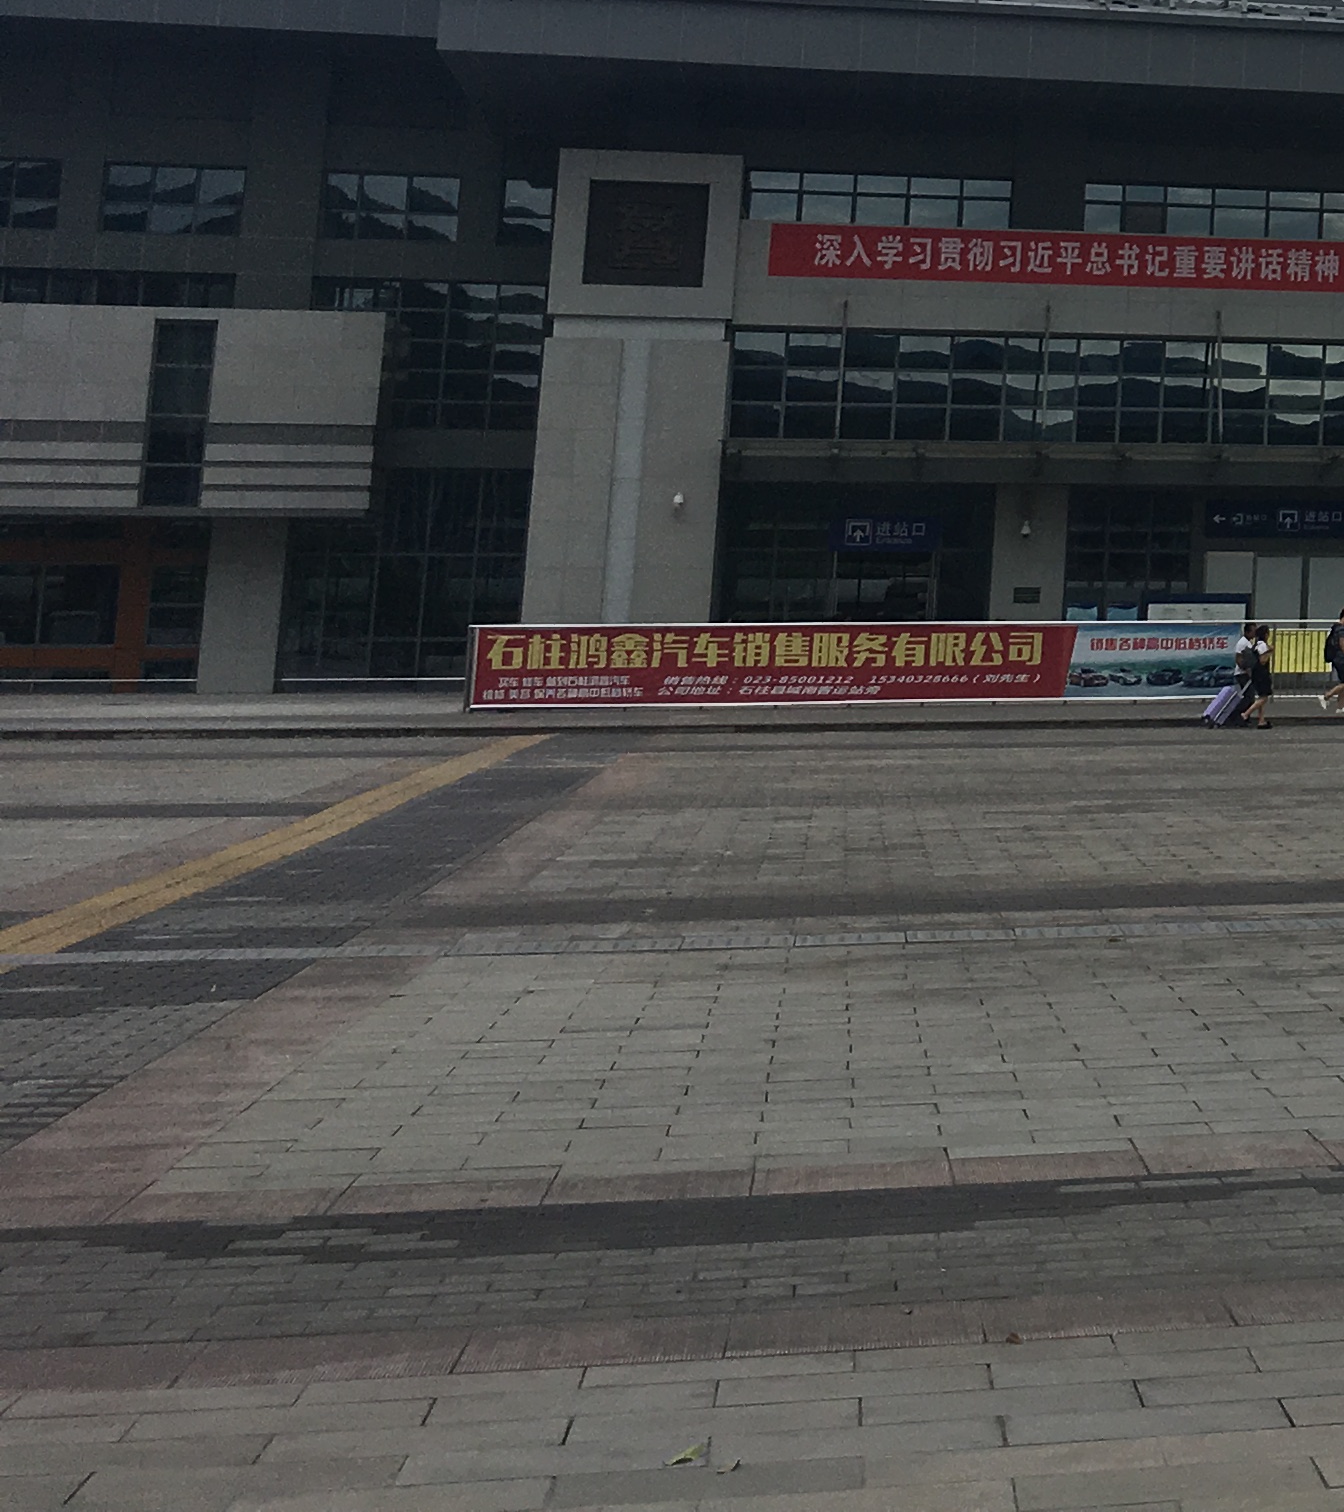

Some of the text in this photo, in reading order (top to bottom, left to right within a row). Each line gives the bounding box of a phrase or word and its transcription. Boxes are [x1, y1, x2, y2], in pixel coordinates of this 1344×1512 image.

[813, 232, 1340, 284] 深入学习贯彻习近平总书记重要讲话精神
[874, 520, 926, 537] 进站口
[486, 631, 1044, 670] 石柱鸿鑫汽车销售服务有限公司
